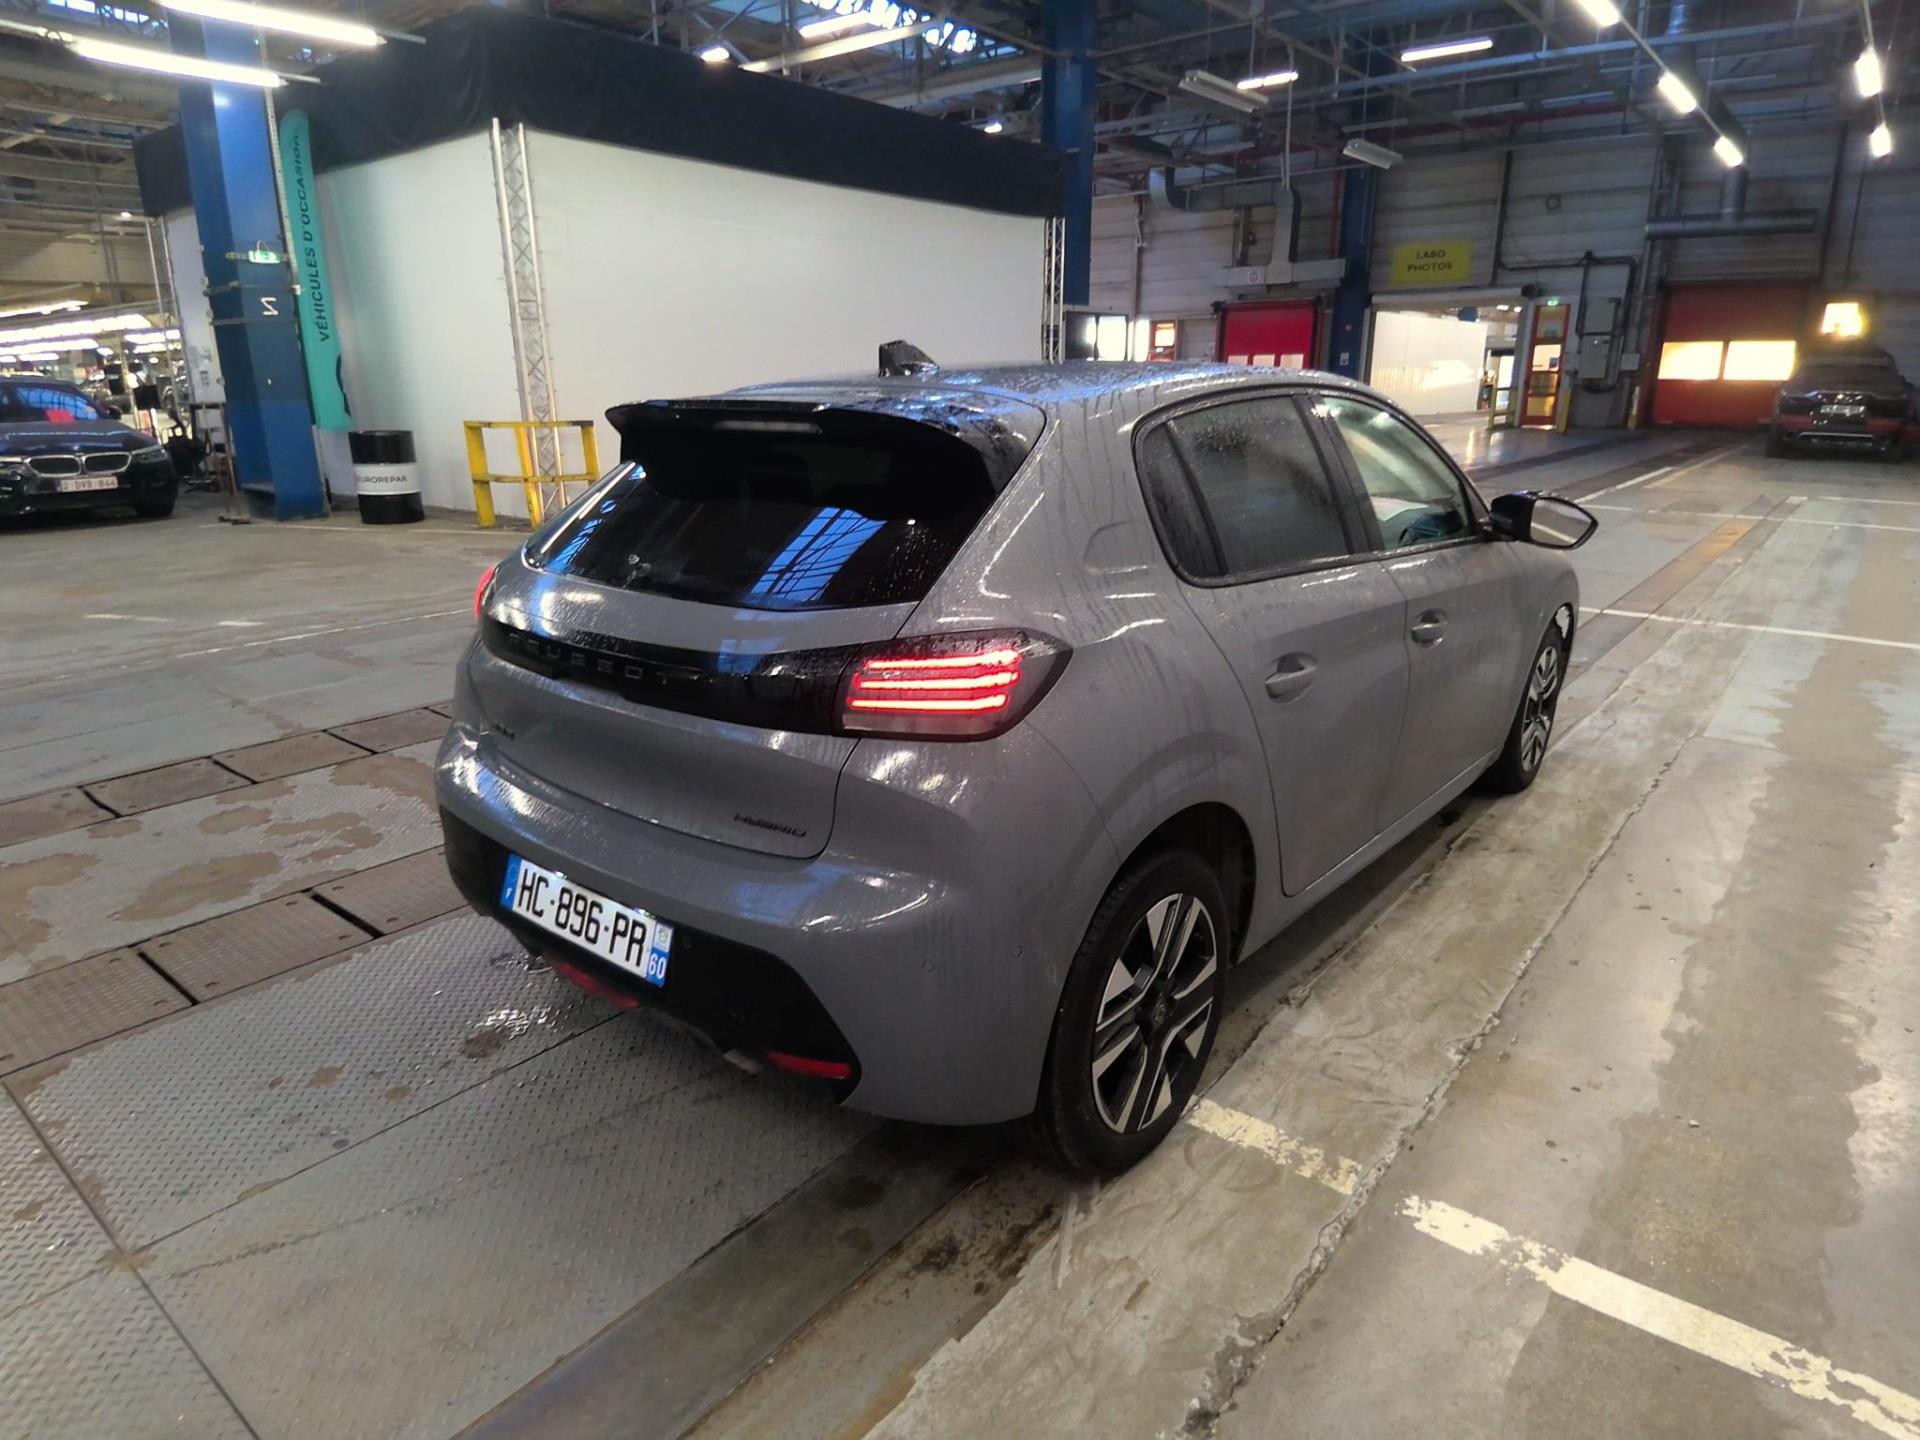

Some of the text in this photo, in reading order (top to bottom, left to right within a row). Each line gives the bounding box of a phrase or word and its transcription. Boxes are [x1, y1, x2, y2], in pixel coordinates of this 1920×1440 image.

[1415, 249, 1446, 260] LABO
[1407, 262, 1453, 272] PHOTOS
[648, 953, 668, 980] 60
